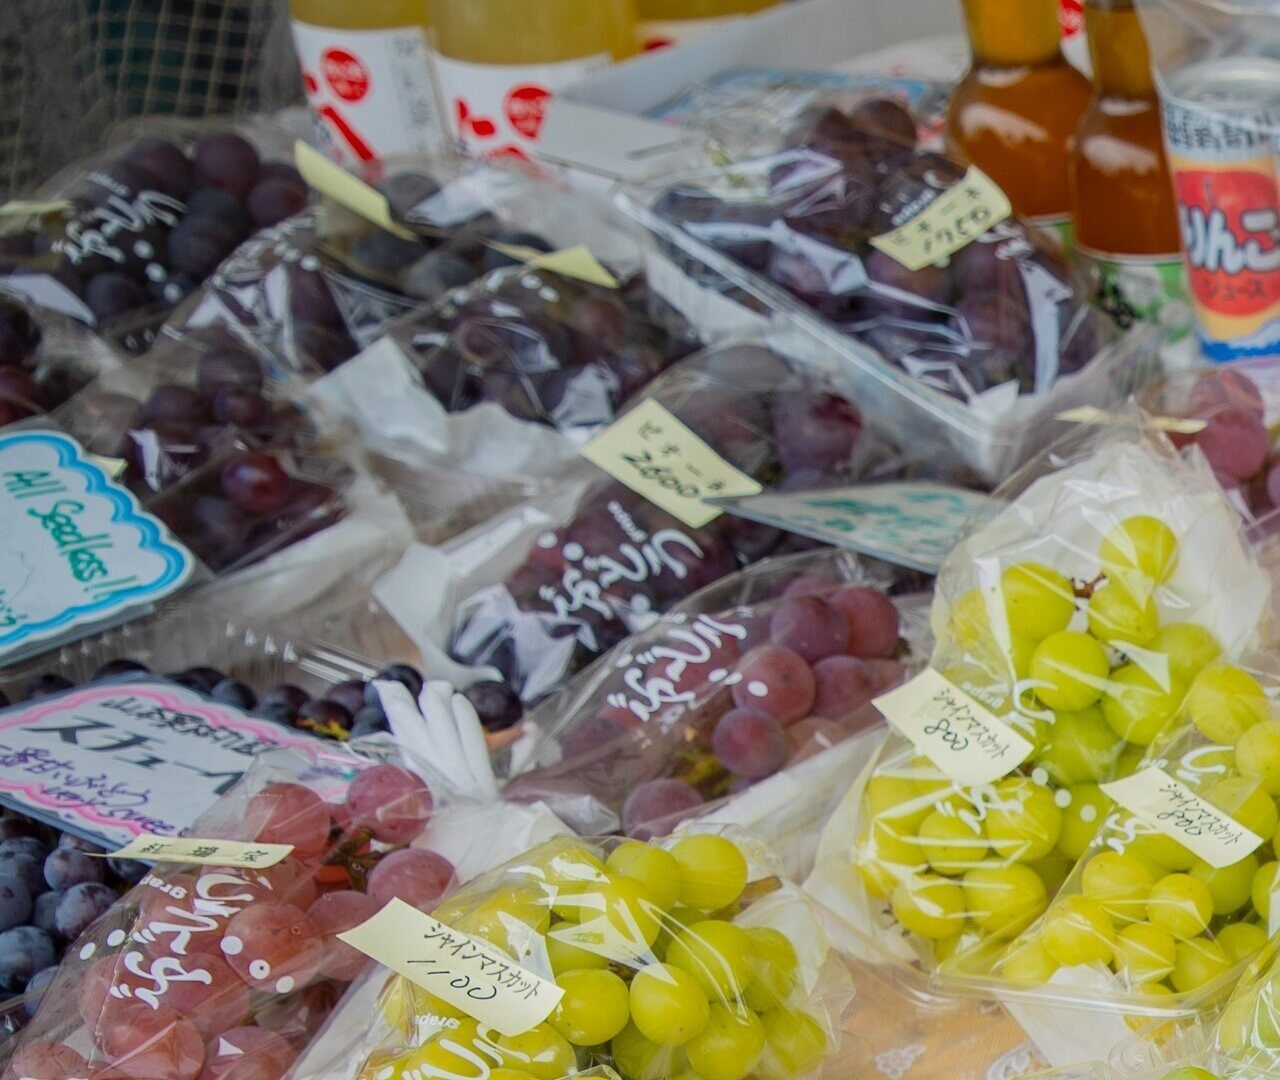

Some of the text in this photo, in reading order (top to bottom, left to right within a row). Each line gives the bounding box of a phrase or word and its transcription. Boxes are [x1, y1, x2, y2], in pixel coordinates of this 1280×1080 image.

[923, 717, 970, 752] 800
[1156, 809, 1203, 836] 800
[423, 922, 543, 1001] シャインマスカット
